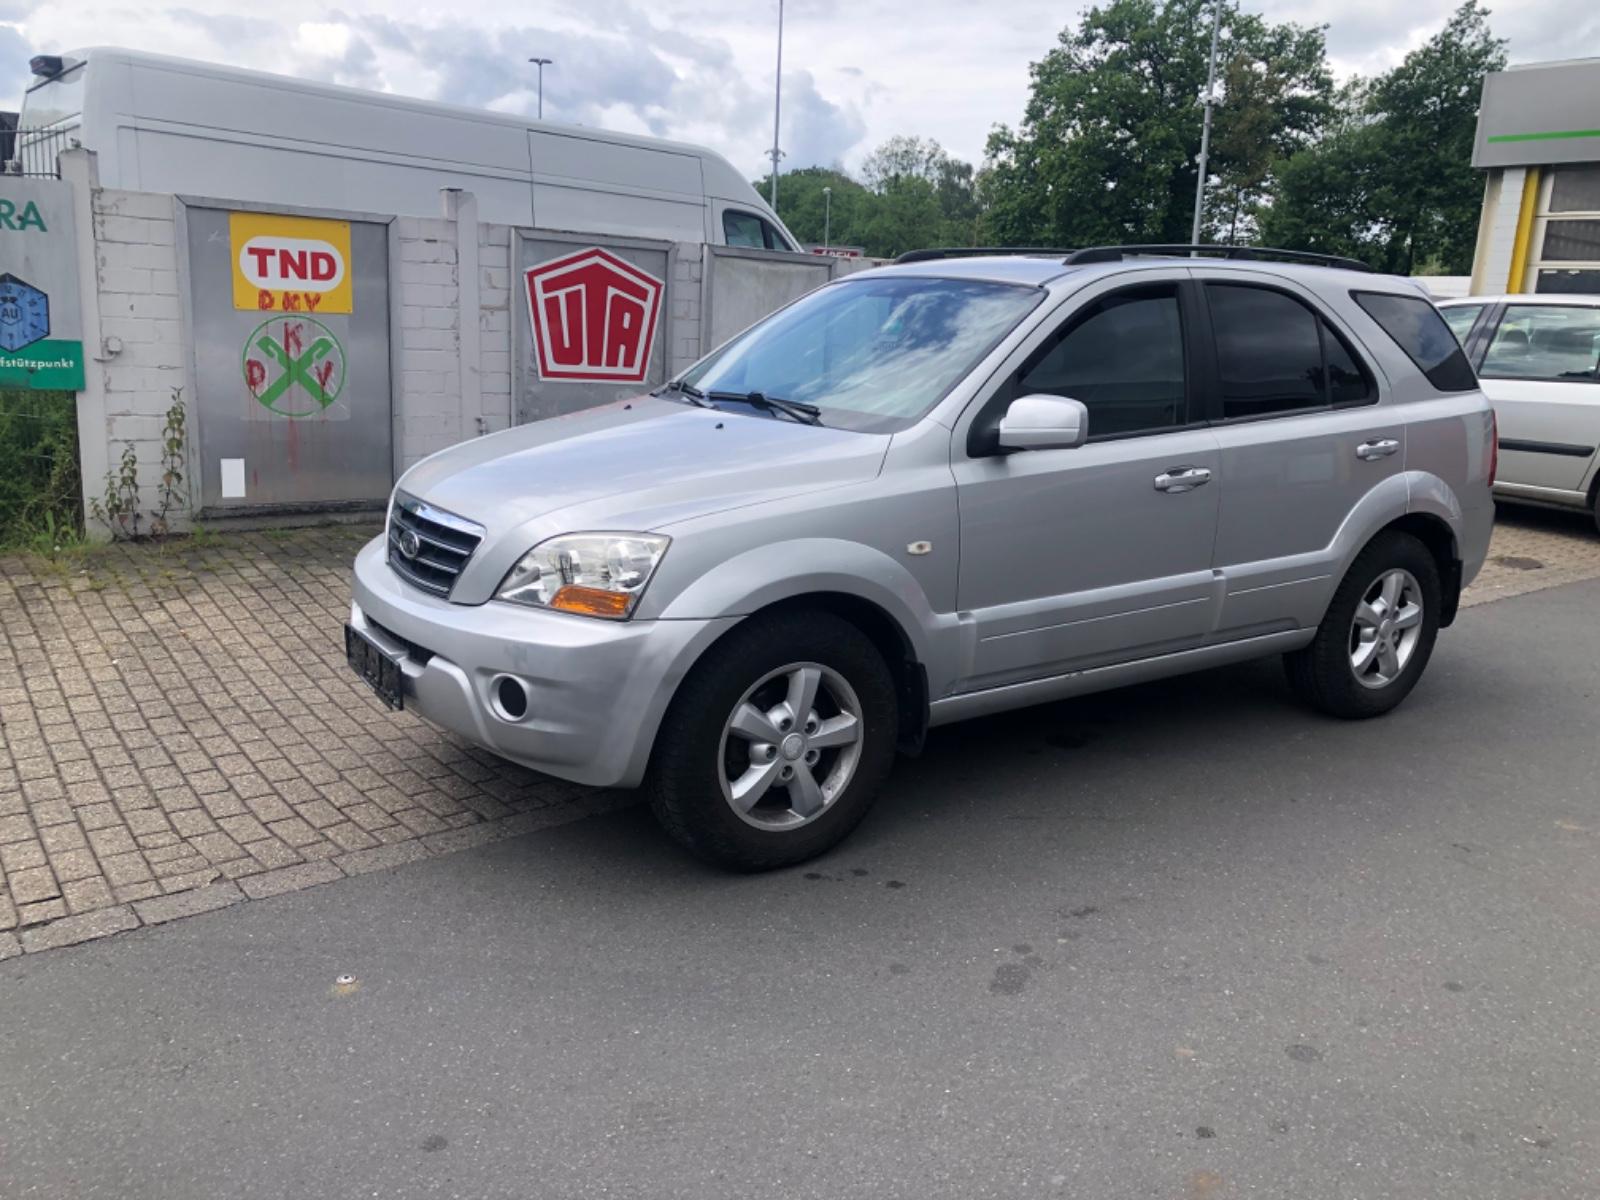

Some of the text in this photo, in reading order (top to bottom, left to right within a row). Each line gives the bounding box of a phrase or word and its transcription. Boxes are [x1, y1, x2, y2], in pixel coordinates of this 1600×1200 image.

[247, 247, 337, 281] TND
[1, 307, 19, 320] AU
[541, 263, 649, 368] UTA
